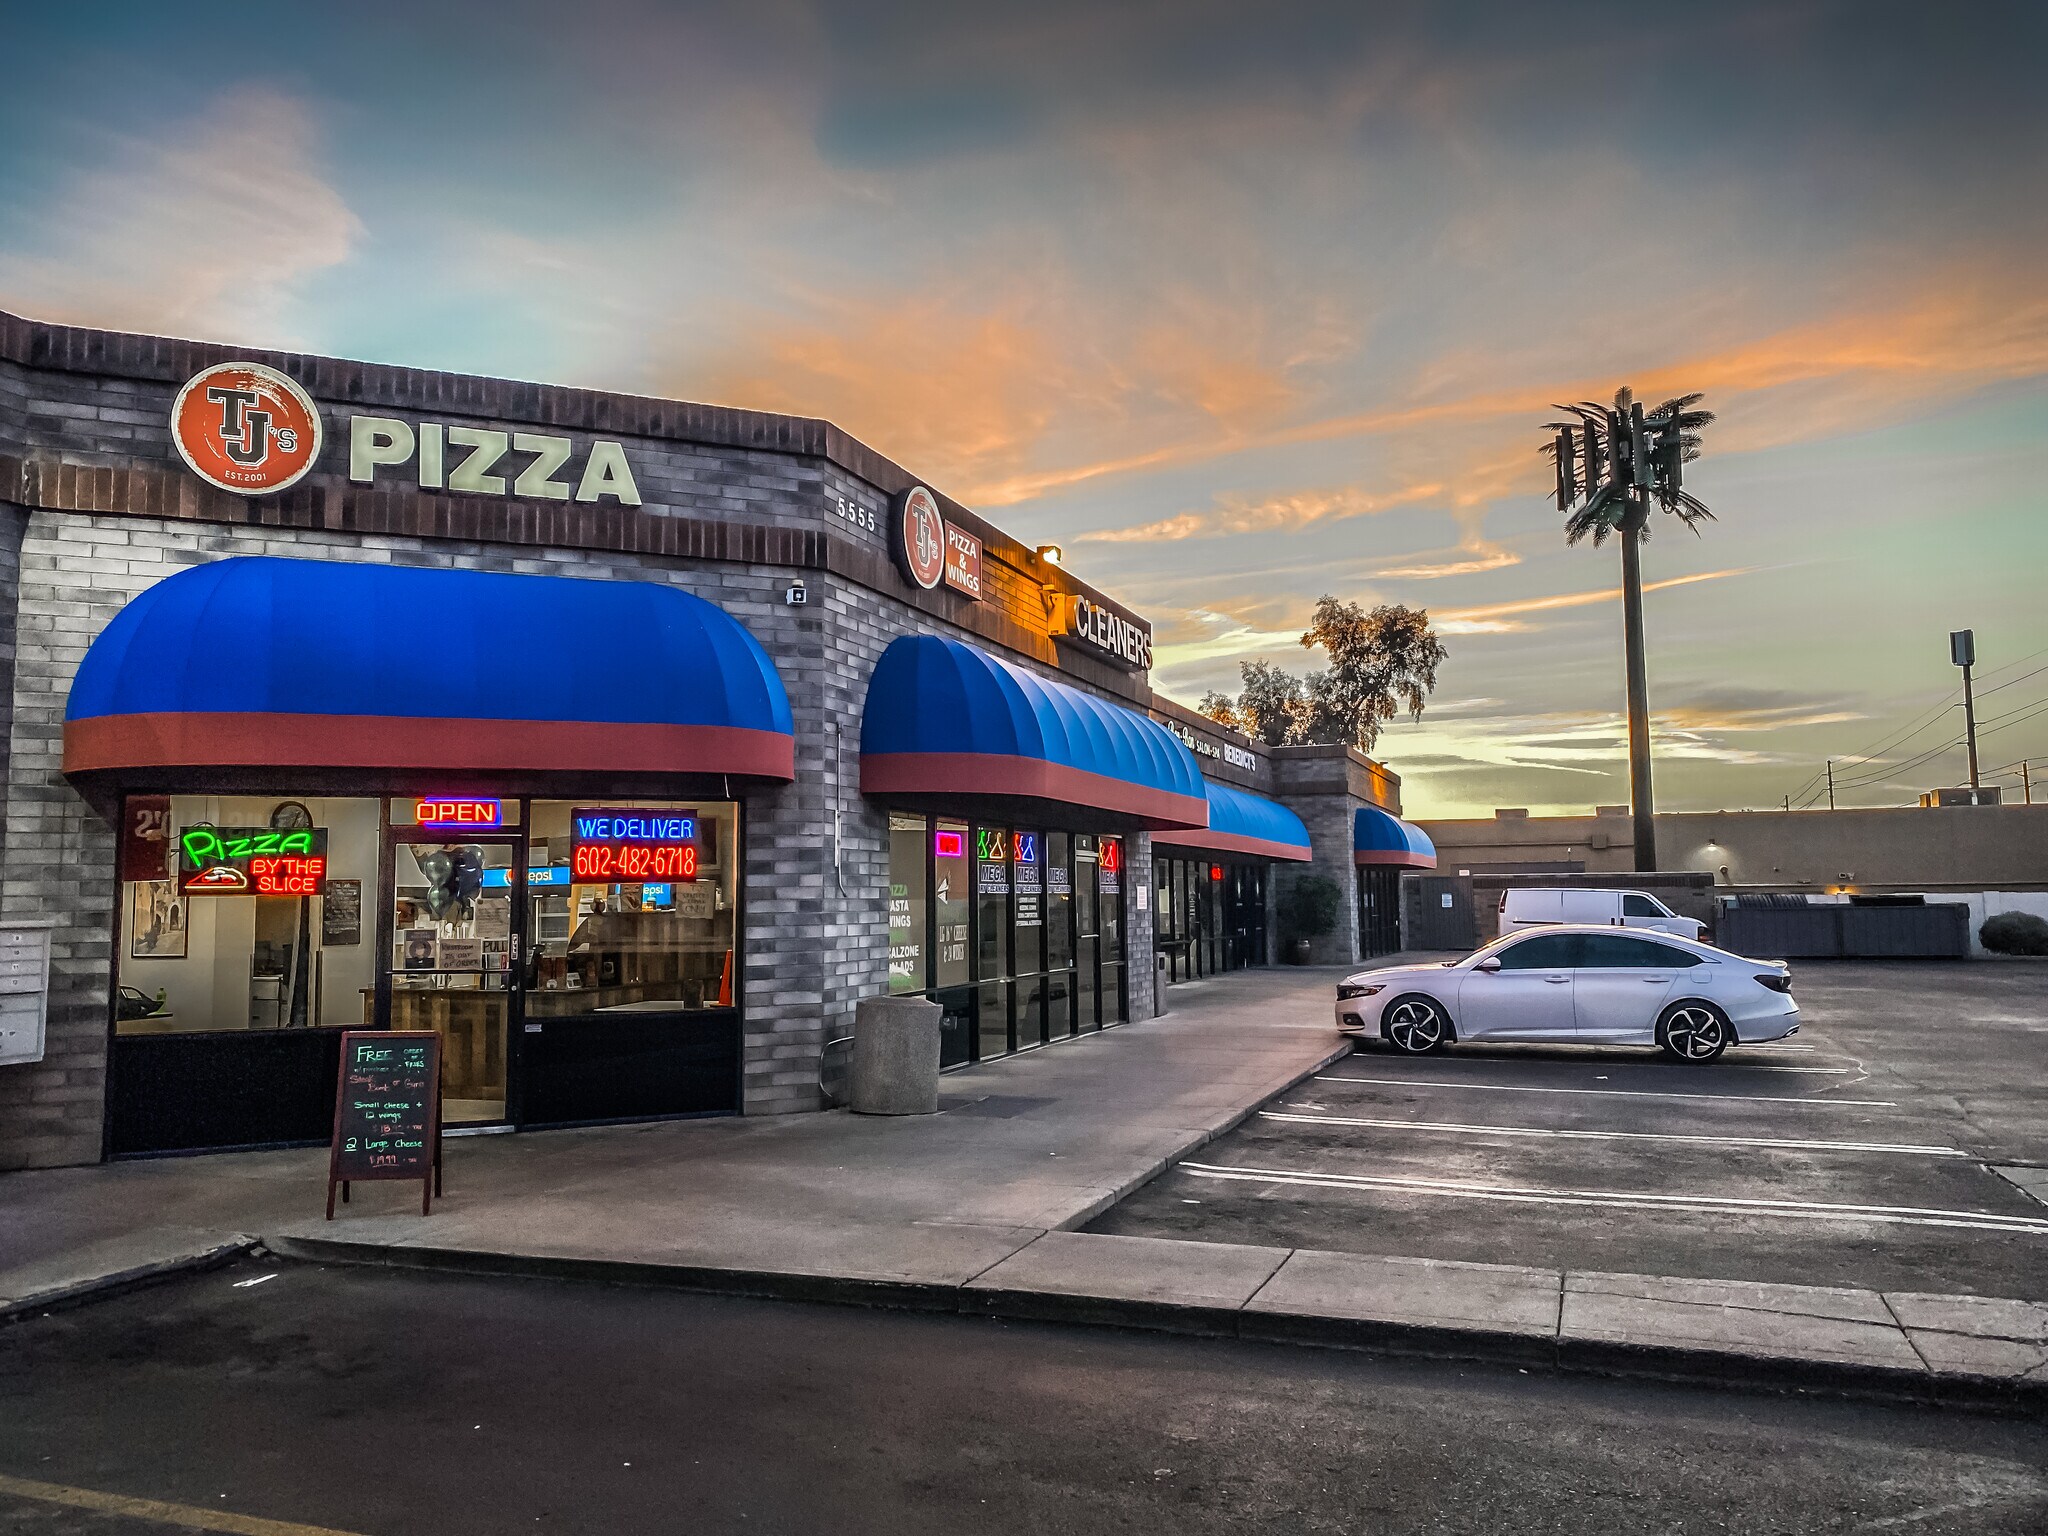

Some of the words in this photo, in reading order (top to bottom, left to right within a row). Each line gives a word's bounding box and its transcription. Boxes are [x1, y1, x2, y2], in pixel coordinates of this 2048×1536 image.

[349, 414, 642, 506] PIZZA
[837, 496, 875, 532] 5555
[949, 529, 977, 559] PIZZA
[959, 553, 967, 570] &
[947, 562, 979, 592] WINGS
[1075, 594, 1153, 671] CLEANERS
[416, 803, 494, 822] OPEN
[578, 817, 610, 838] WE
[613, 818, 693, 839] DELIVER
[182, 831, 313, 868] PIZZA
[252, 858, 280, 875] BY
[282, 859, 322, 875] THE
[577, 845, 695, 876] 602-482-6718
[528, 869, 553, 882] epsi
[980, 864, 1007, 882] MEGA
[1016, 866, 1039, 883] MEGA
[258, 876, 315, 892] SLICE
[643, 884, 664, 896] epsi
[890, 884, 908, 896] IZZA
[889, 899, 910, 912] ASTA
[356, 1045, 394, 1062] FREE
[354, 1101, 380, 1109] Small
[346, 1137, 357, 1149] 2
[365, 1137, 390, 1153] Large
